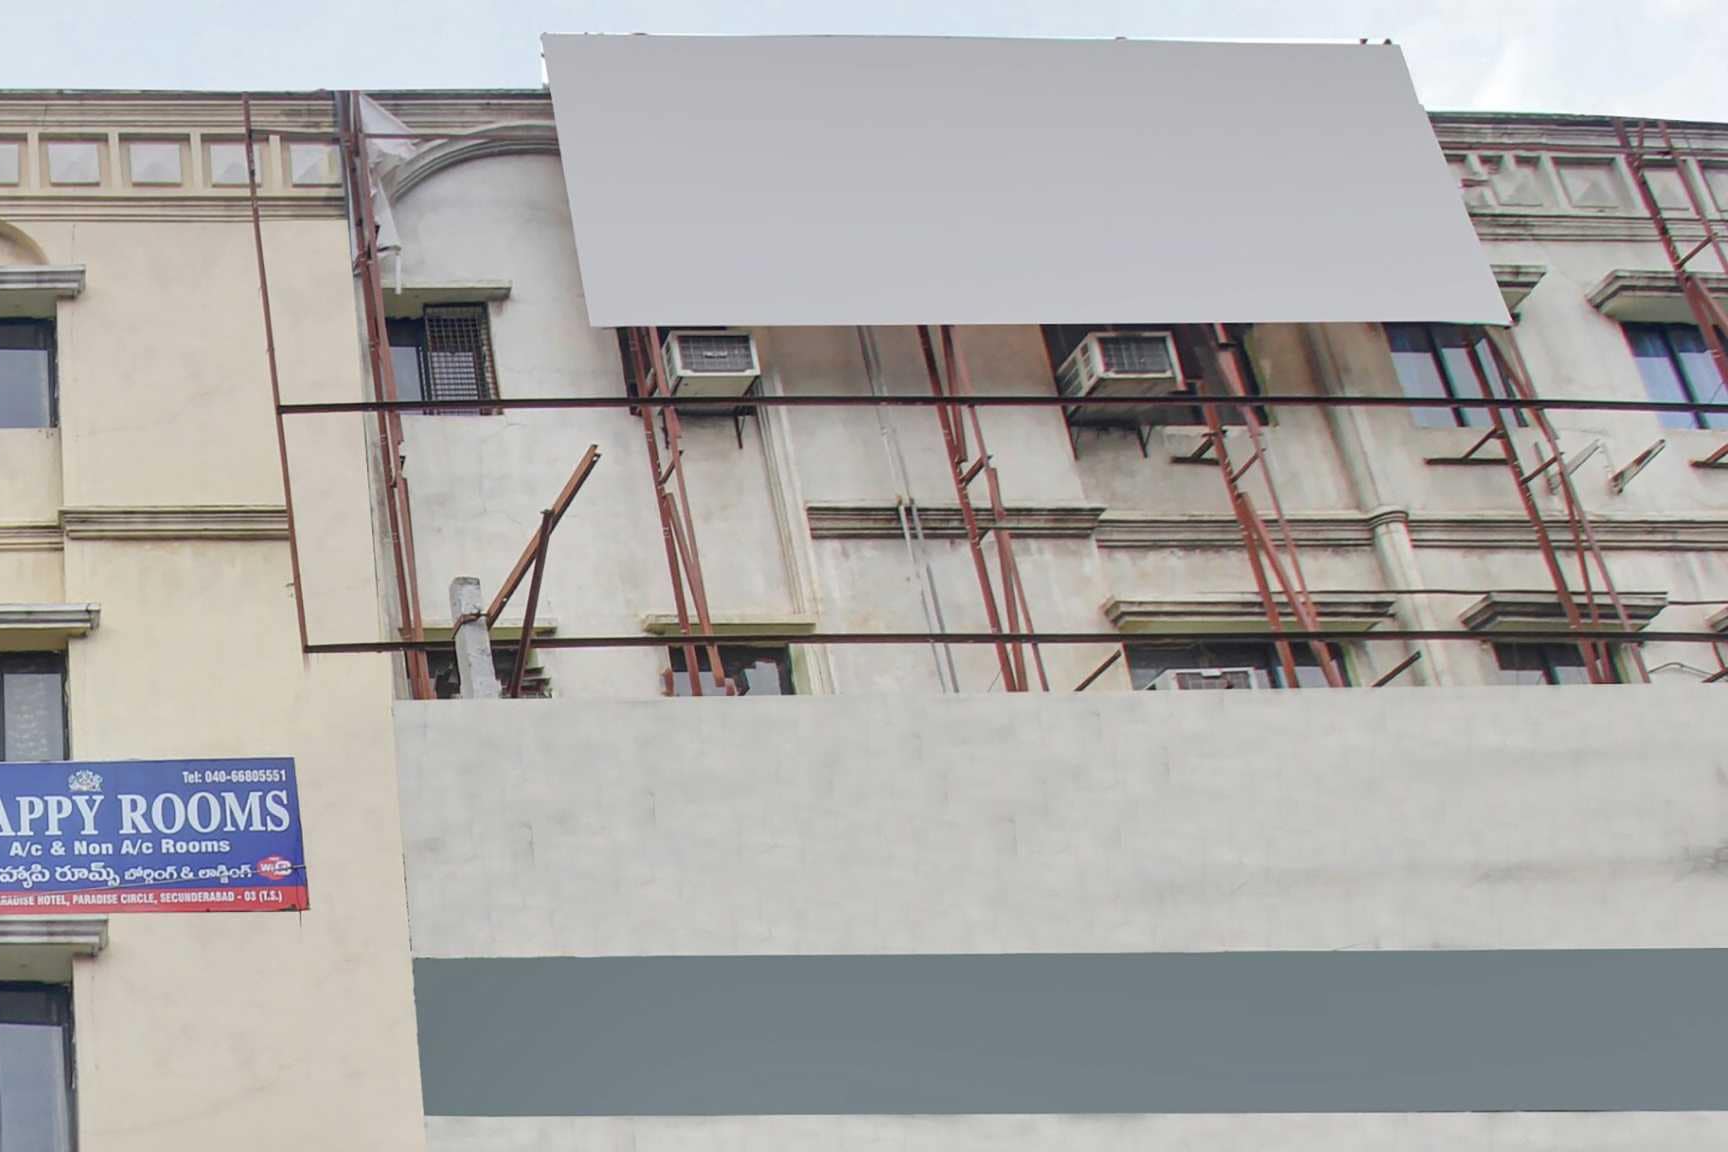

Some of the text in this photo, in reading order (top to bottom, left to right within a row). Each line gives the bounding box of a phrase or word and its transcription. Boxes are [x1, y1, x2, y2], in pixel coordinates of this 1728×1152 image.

[117, 790, 290, 834] ROOMS
[10, 838, 230, 857] A/c & Non A/c Rooms
